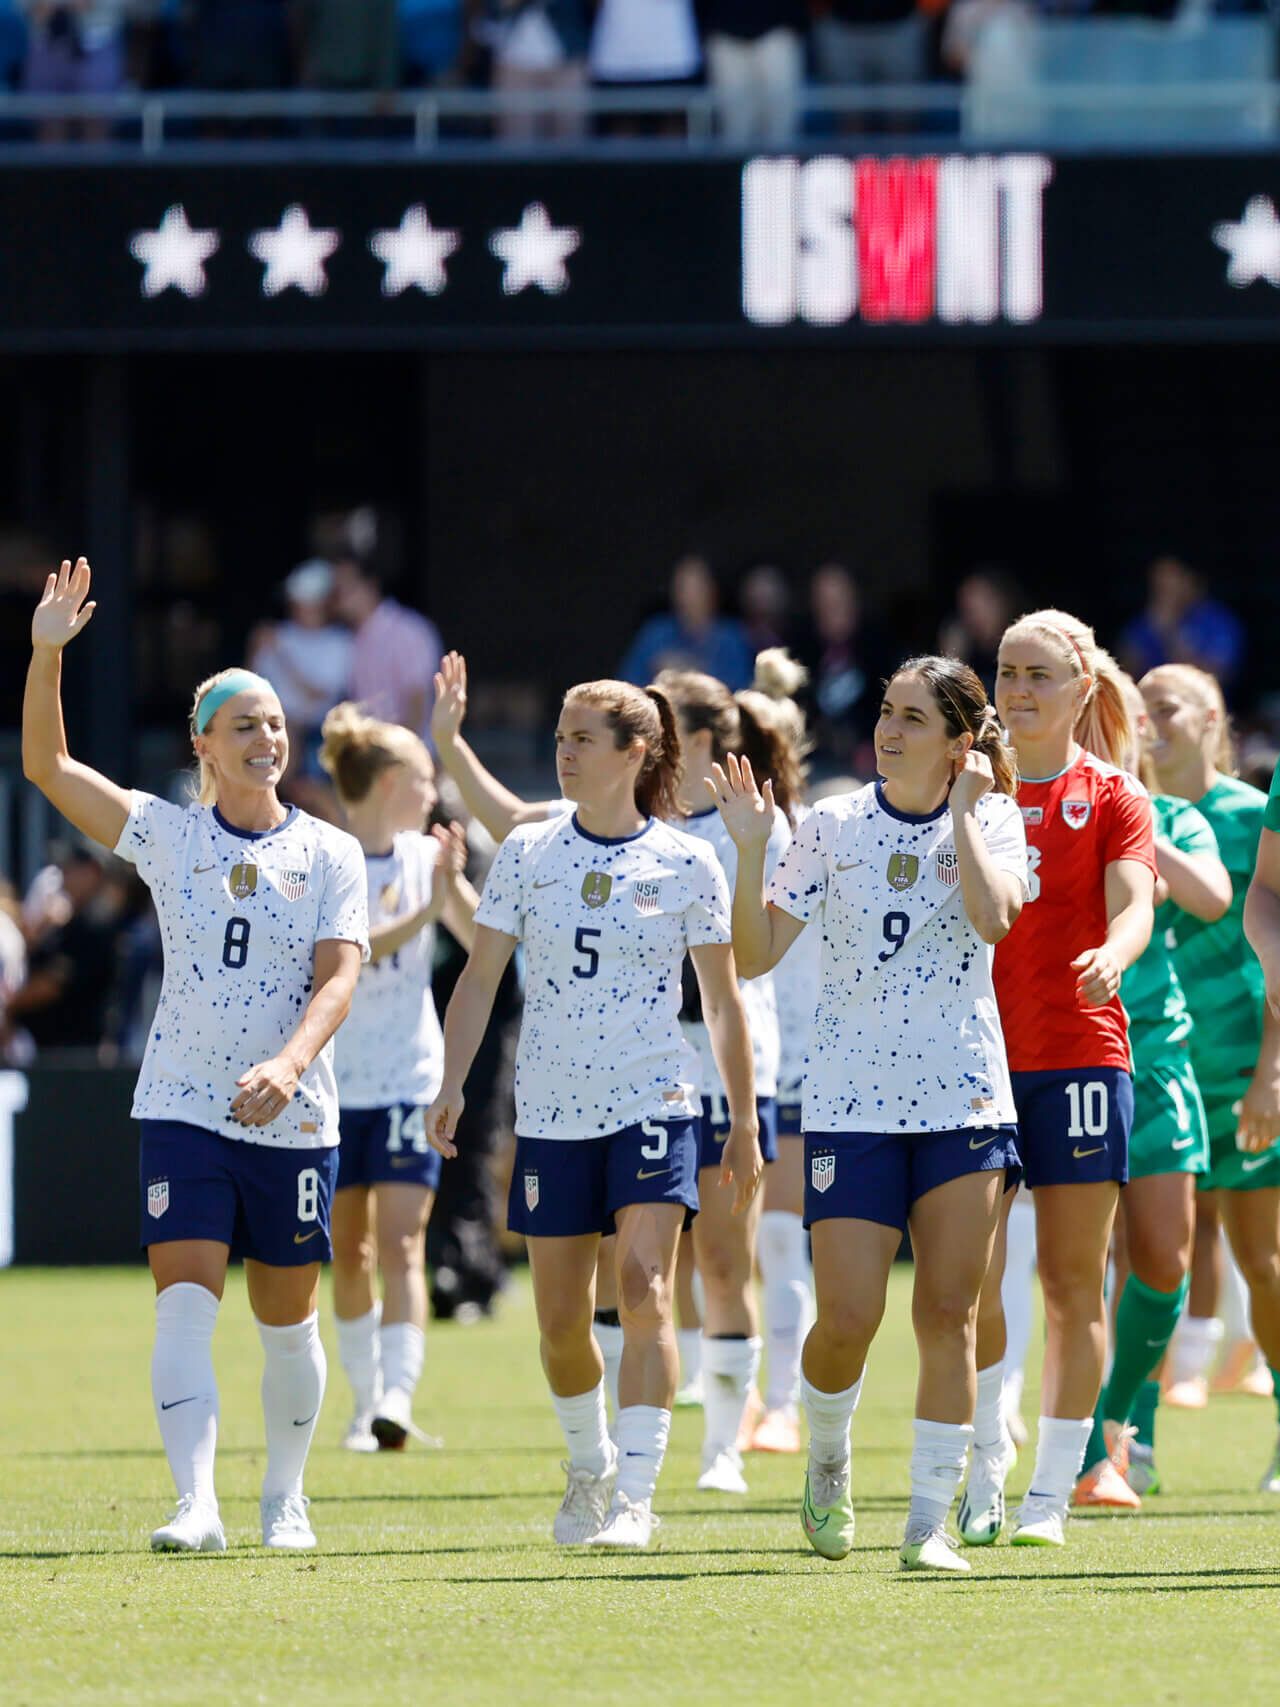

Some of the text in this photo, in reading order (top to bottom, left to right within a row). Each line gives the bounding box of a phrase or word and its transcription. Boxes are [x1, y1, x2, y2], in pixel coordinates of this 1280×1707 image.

[741, 155, 1053, 325] USWNT
[283, 872, 306, 885] USA
[636, 882, 659, 896] USA
[894, 876, 909, 884] FIFA
[222, 916, 251, 969] 8
[573, 926, 601, 979] 5
[878, 911, 910, 962] 9
[386, 1105, 429, 1153] 14
[1065, 1081, 1108, 1137] 10
[641, 1119, 668, 1160] 5
[813, 1157, 833, 1172] USA
[149, 1184, 168, 1198] USA
[297, 1168, 318, 1222] 8
